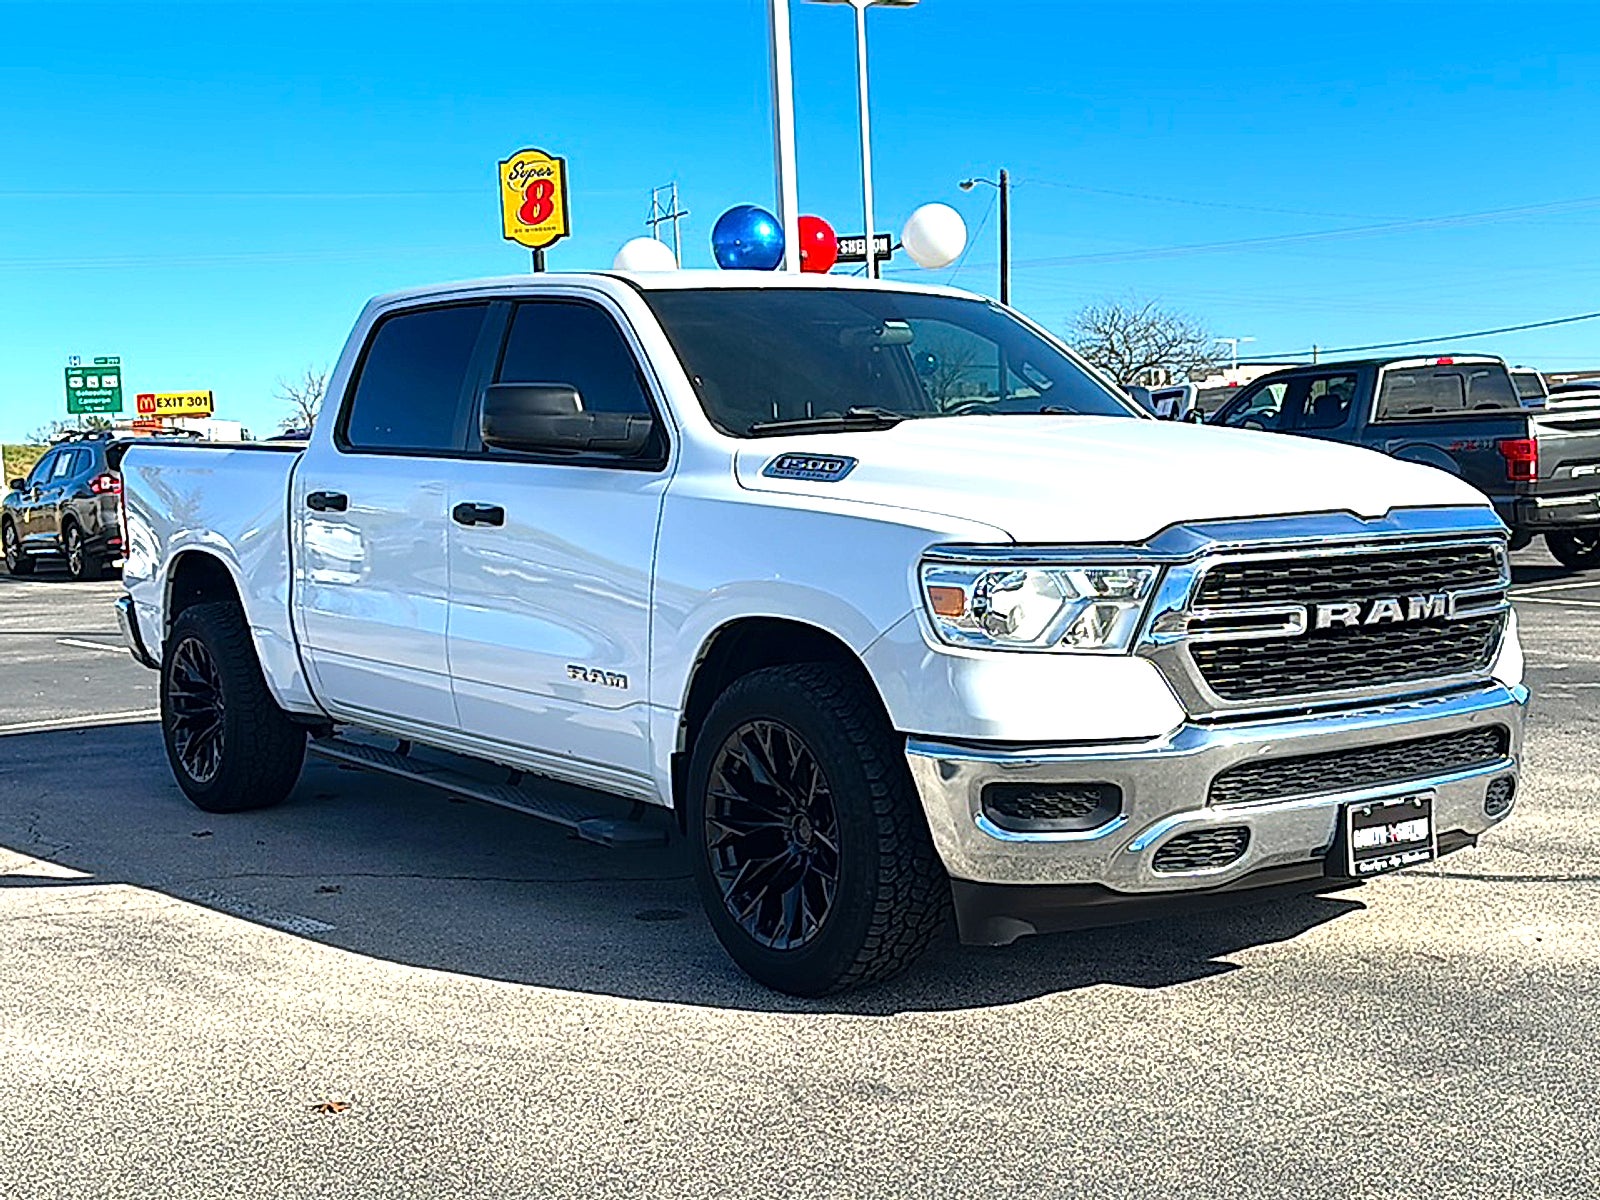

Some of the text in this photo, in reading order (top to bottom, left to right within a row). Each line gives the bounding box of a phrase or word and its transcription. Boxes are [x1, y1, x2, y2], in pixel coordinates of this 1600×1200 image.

[508, 160, 554, 188] Super
[516, 179, 555, 226] 8
[840, 238, 888, 254] SHEON
[156, 396, 184, 408] EXIT
[186, 396, 208, 406] 301
[781, 458, 842, 471] 1500
[1315, 593, 1447, 630] RAM
[566, 663, 629, 690] RAM
